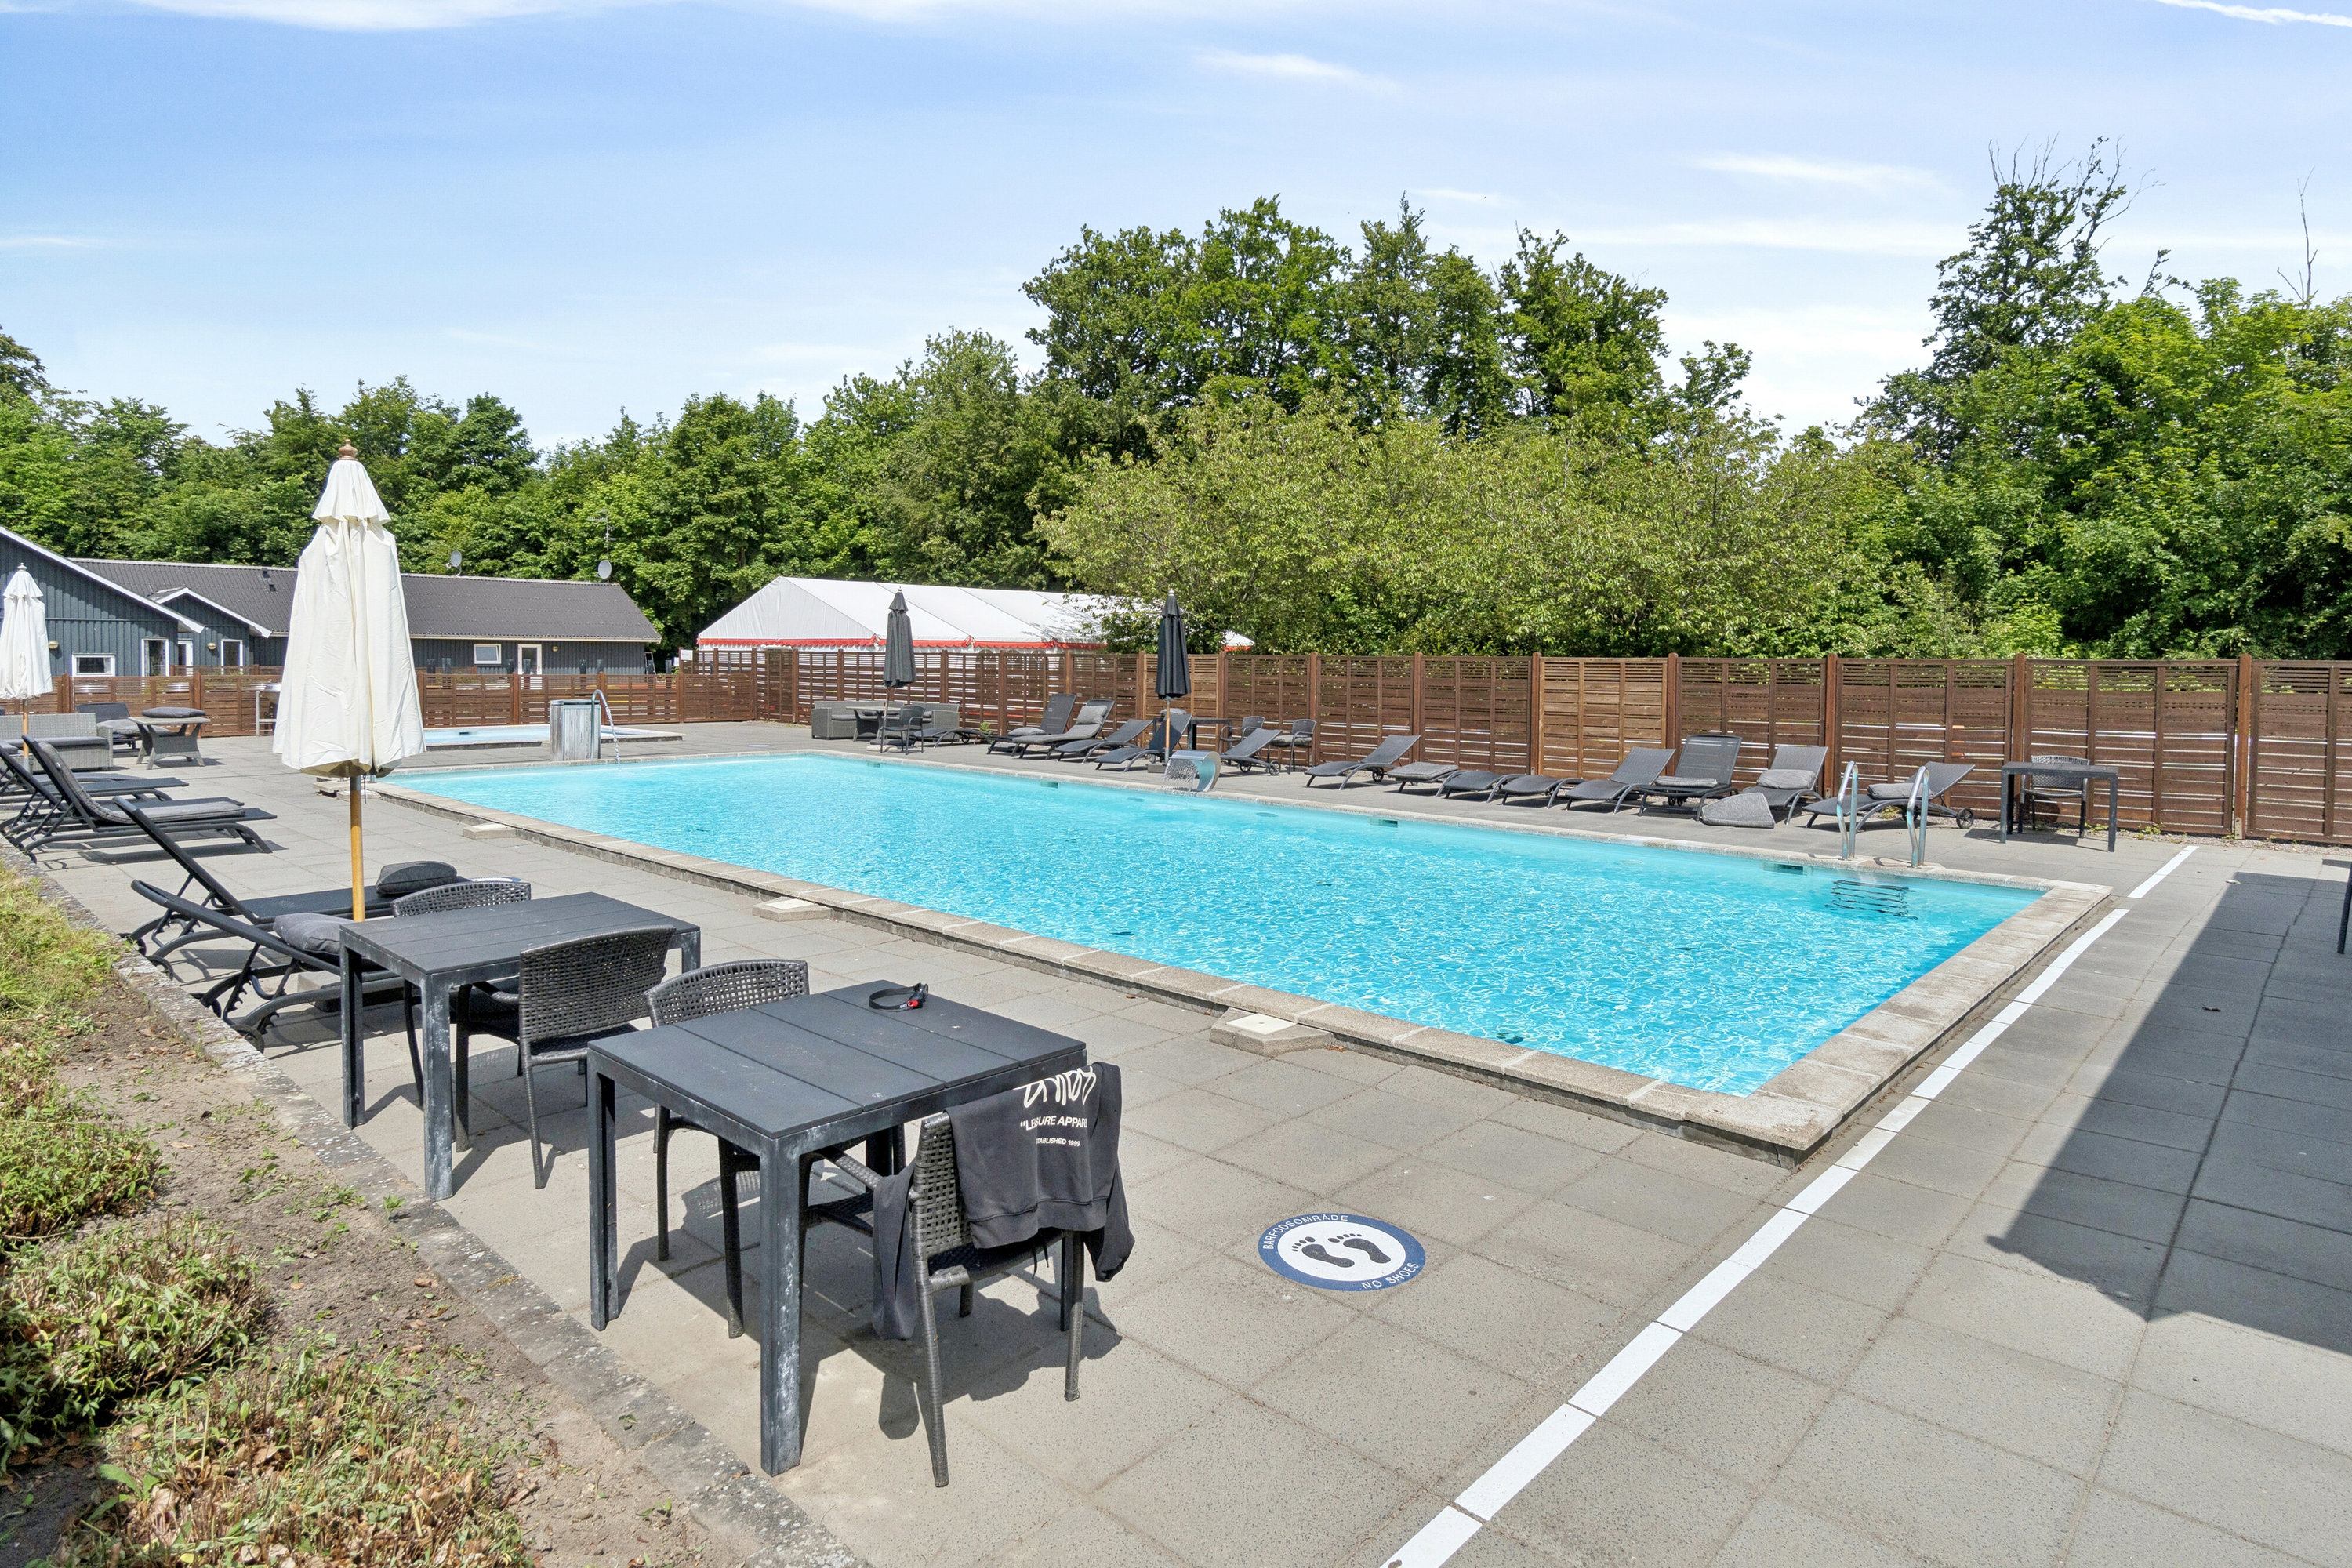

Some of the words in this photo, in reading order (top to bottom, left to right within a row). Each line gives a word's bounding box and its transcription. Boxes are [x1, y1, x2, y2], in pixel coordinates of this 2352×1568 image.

[1262, 1214, 1348, 1250] BARFODSOMRÅDE
[1361, 1280, 1382, 1289] NO
[1385, 1262, 1419, 1283] SHOES
